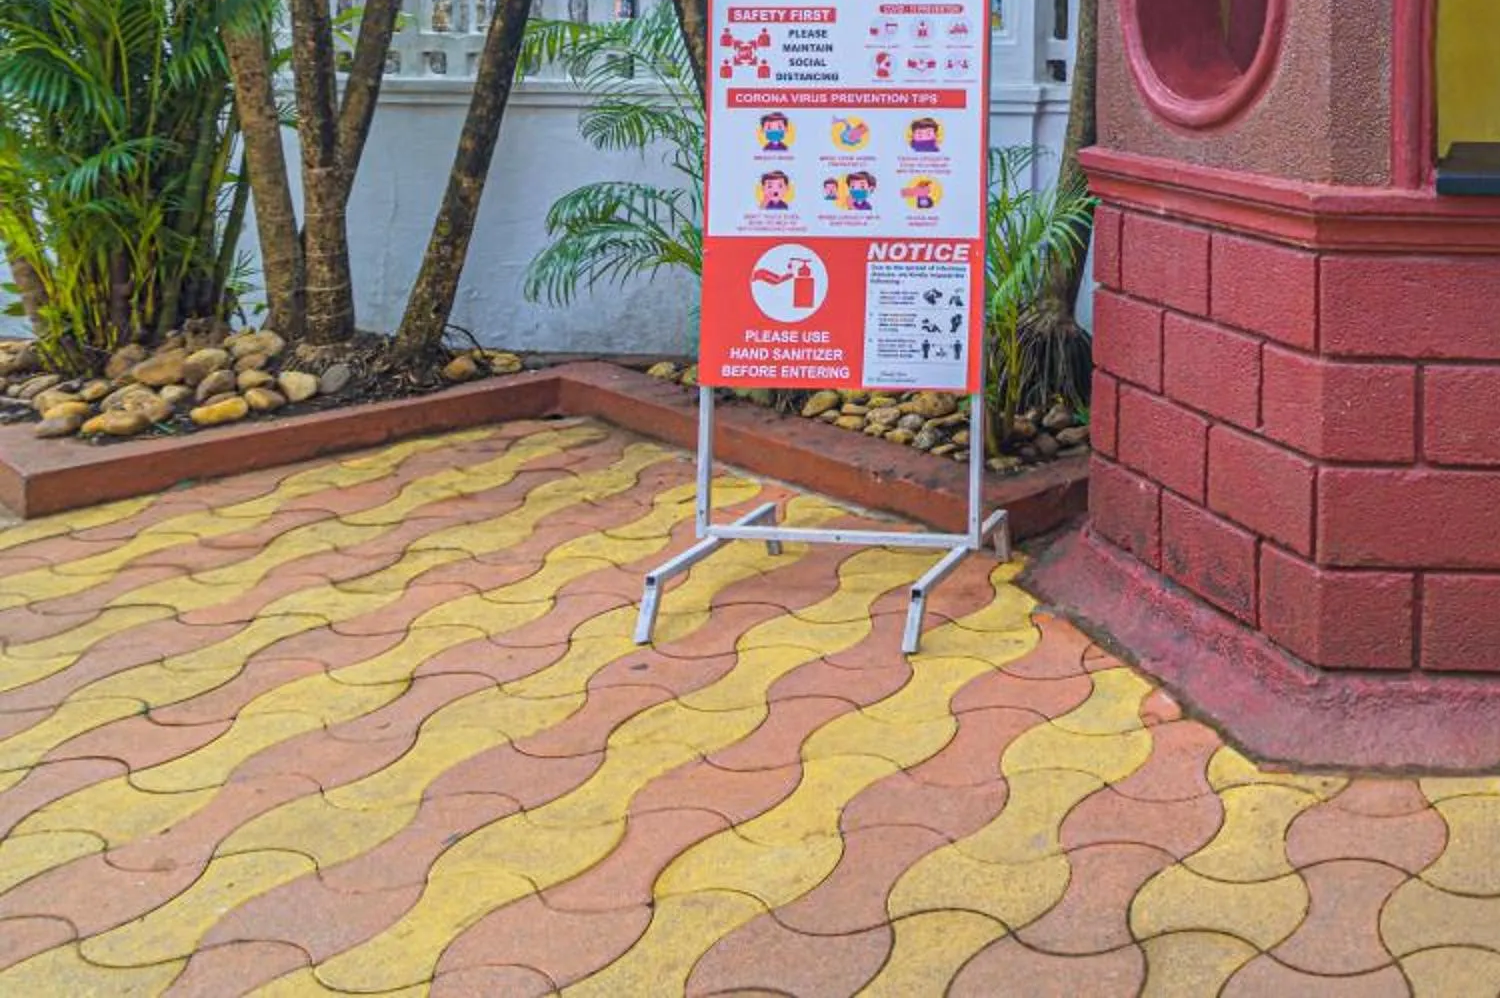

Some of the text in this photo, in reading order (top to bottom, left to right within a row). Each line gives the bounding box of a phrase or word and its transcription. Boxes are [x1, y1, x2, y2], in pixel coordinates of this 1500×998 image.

[733, 9, 831, 21] SAFETY FIRST
[788, 29, 828, 39] PLEASE
[783, 43, 833, 52] MAINTAIN
[789, 58, 827, 67] SOCIAL
[776, 72, 839, 81] DISTANCING
[735, 93, 938, 104] CORONA VIRUS PREVENTION TIPS
[867, 243, 971, 261] NOTICE
[745, 330, 831, 343] PLEASE USE
[729, 347, 843, 361] HAND SANITIZER
[721, 365, 850, 379] BEFORE ENTERING
